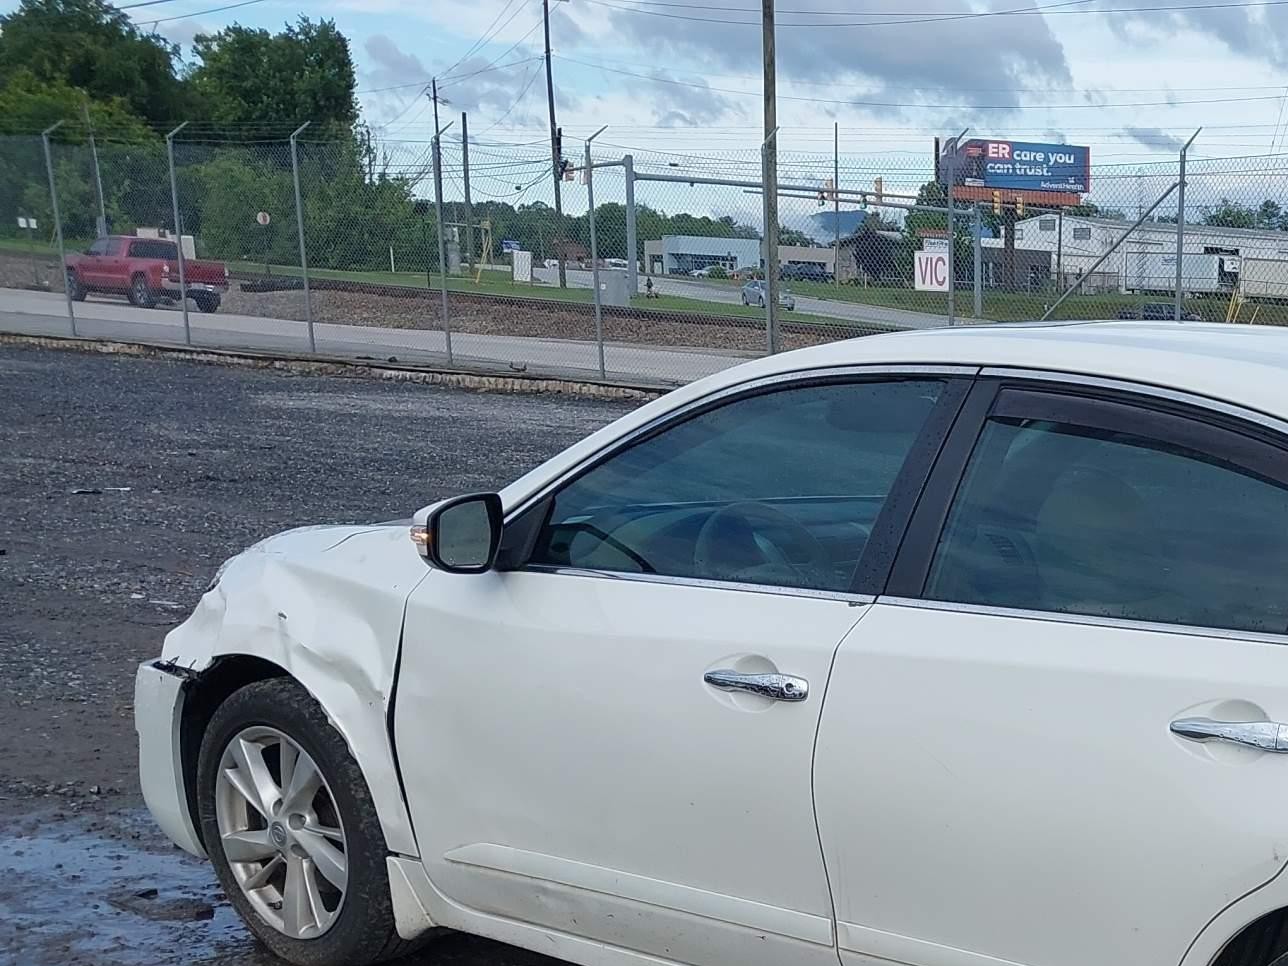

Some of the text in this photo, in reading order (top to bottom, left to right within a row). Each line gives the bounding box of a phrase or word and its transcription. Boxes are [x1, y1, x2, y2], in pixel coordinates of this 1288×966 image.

[988, 143, 1010, 159] ER
[1013, 150, 1044, 161] care
[1048, 153, 1074, 165] you
[987, 162, 1052, 176] can trust.
[918, 256, 946, 286] VIC
